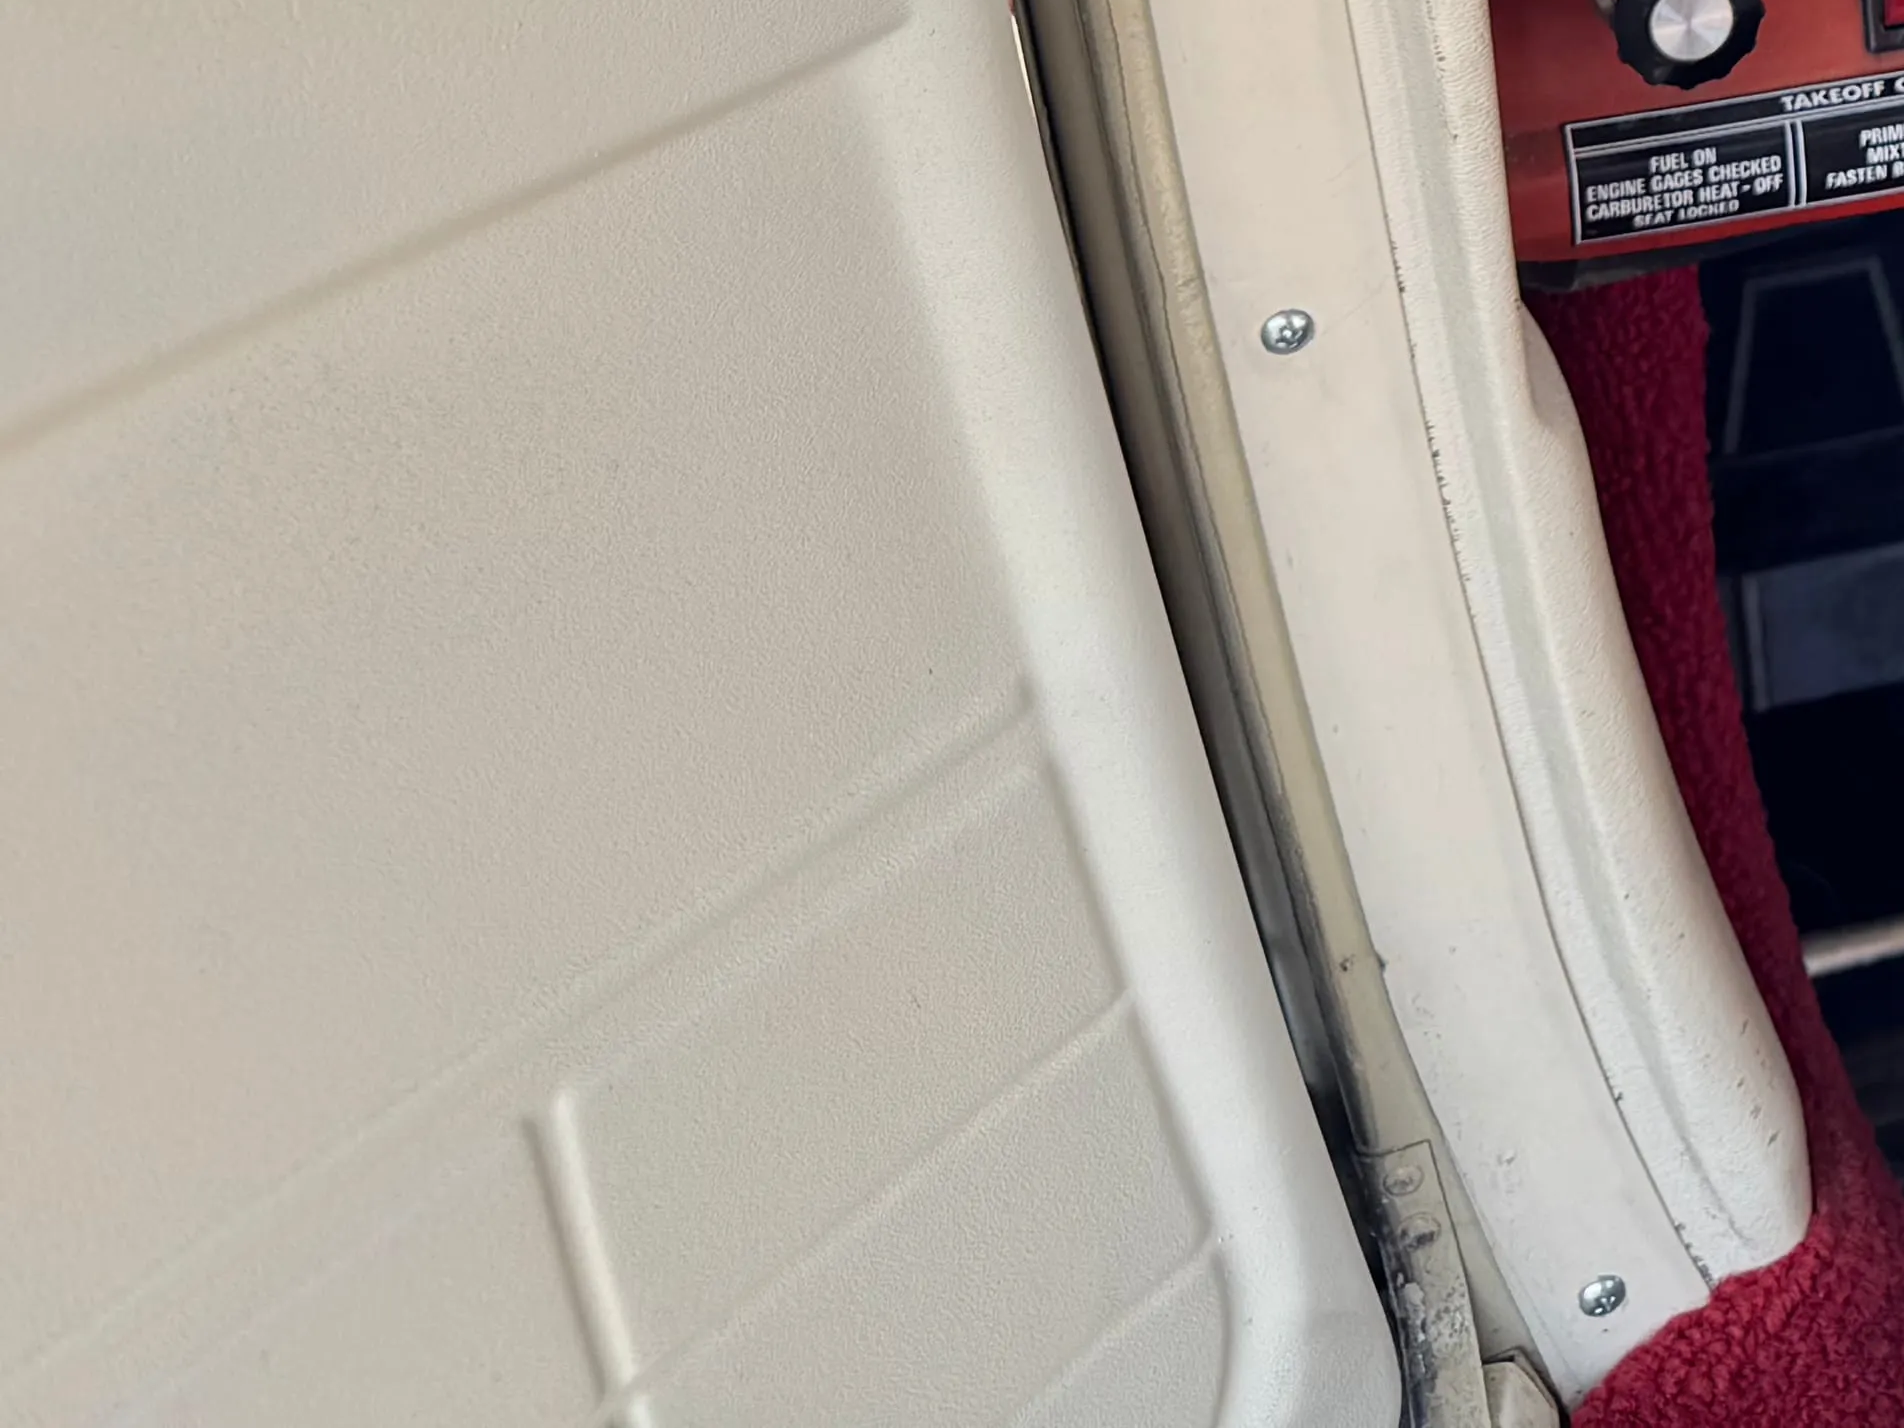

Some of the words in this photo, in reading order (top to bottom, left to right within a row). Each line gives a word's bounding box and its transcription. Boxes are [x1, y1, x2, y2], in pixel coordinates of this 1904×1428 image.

[1780, 81, 1885, 112] TAKEOFF
[1649, 152, 1689, 175] FUEL
[1692, 147, 1718, 167] ON
[1585, 178, 1646, 204] ENGINE
[1650, 168, 1704, 193] GAGES
[1707, 155, 1782, 182] CHECKED
[1824, 164, 1889, 191] FASTEN
[1585, 190, 1694, 223] CARBURETOR
[1698, 181, 1739, 203] HEAT
[1752, 174, 1784, 197] OFF
[1632, 210, 1675, 230] SEAT
[1678, 199, 1740, 221] LOCKED
